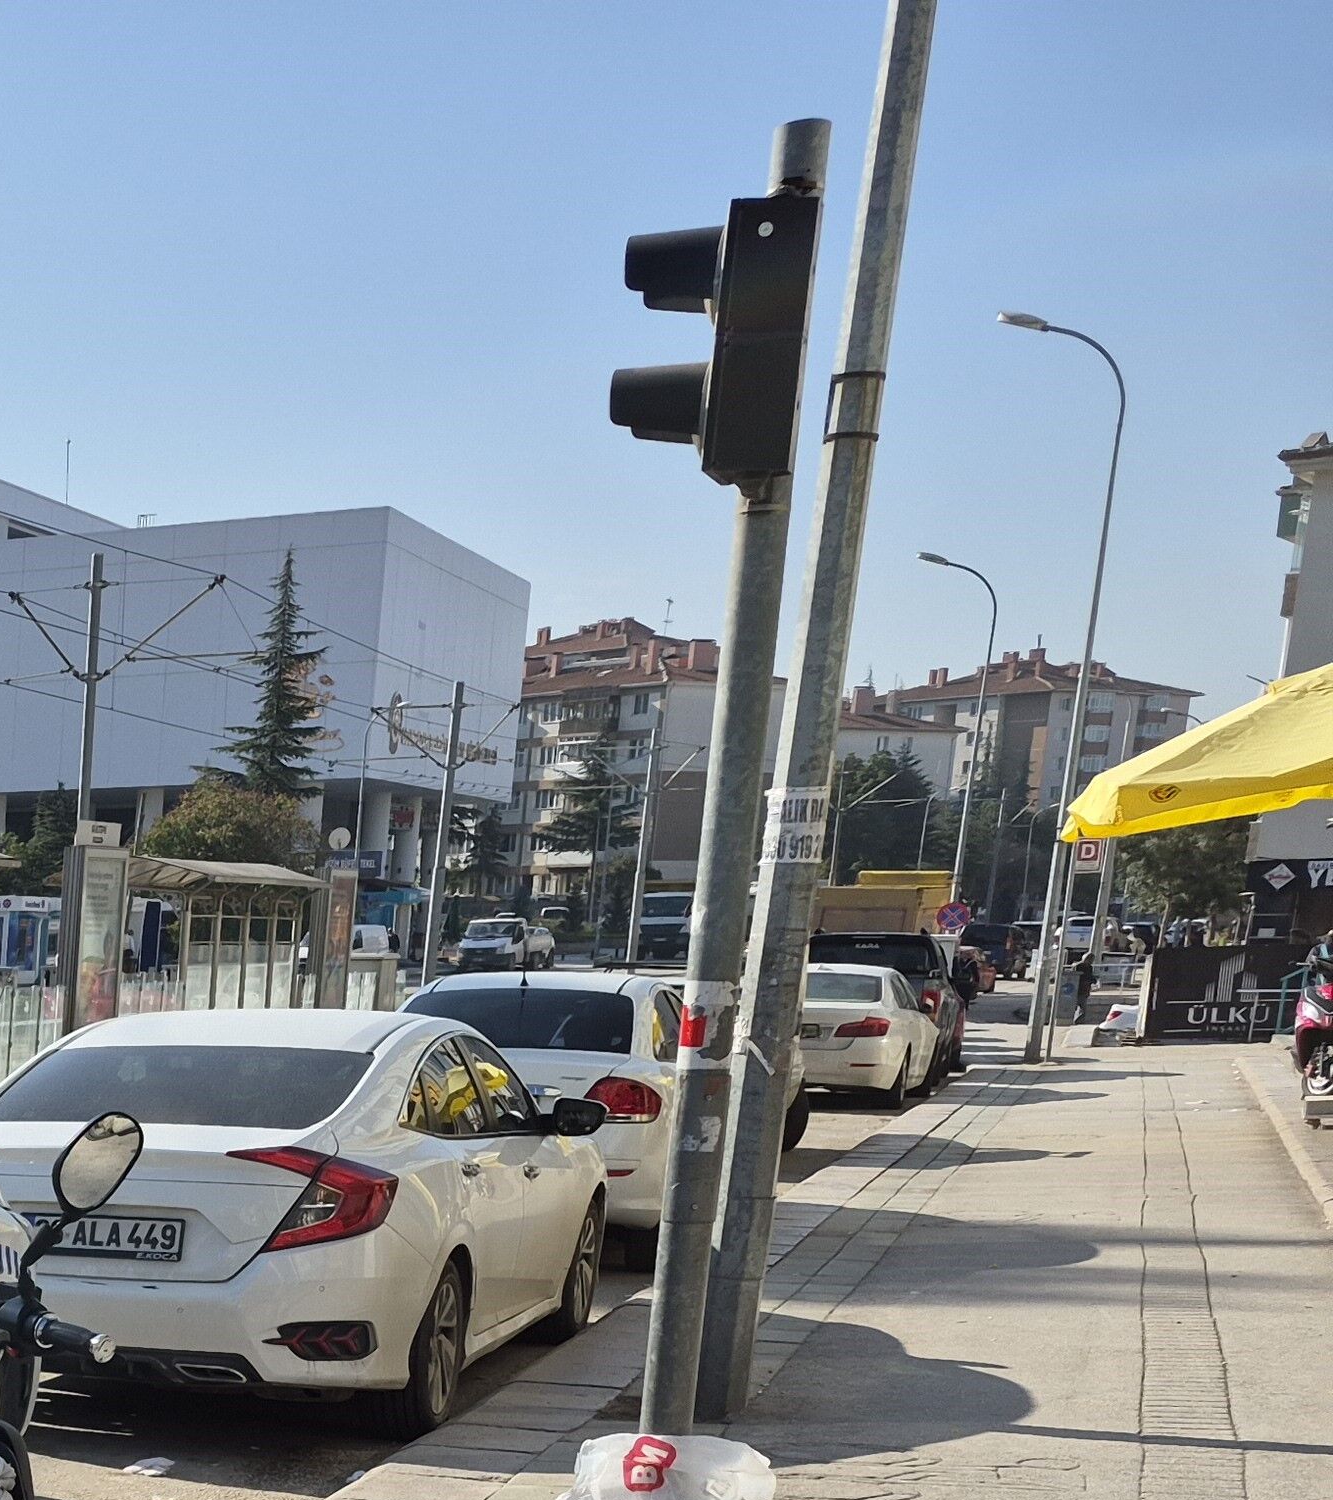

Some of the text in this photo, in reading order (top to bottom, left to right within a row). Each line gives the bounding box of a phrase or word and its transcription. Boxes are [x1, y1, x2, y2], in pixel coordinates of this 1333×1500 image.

[1081, 843, 1096, 859] D
[1188, 1004, 1270, 1025] ÜLKÜ
[72, 1222, 121, 1247] ALA
[127, 1222, 177, 1250] 449
